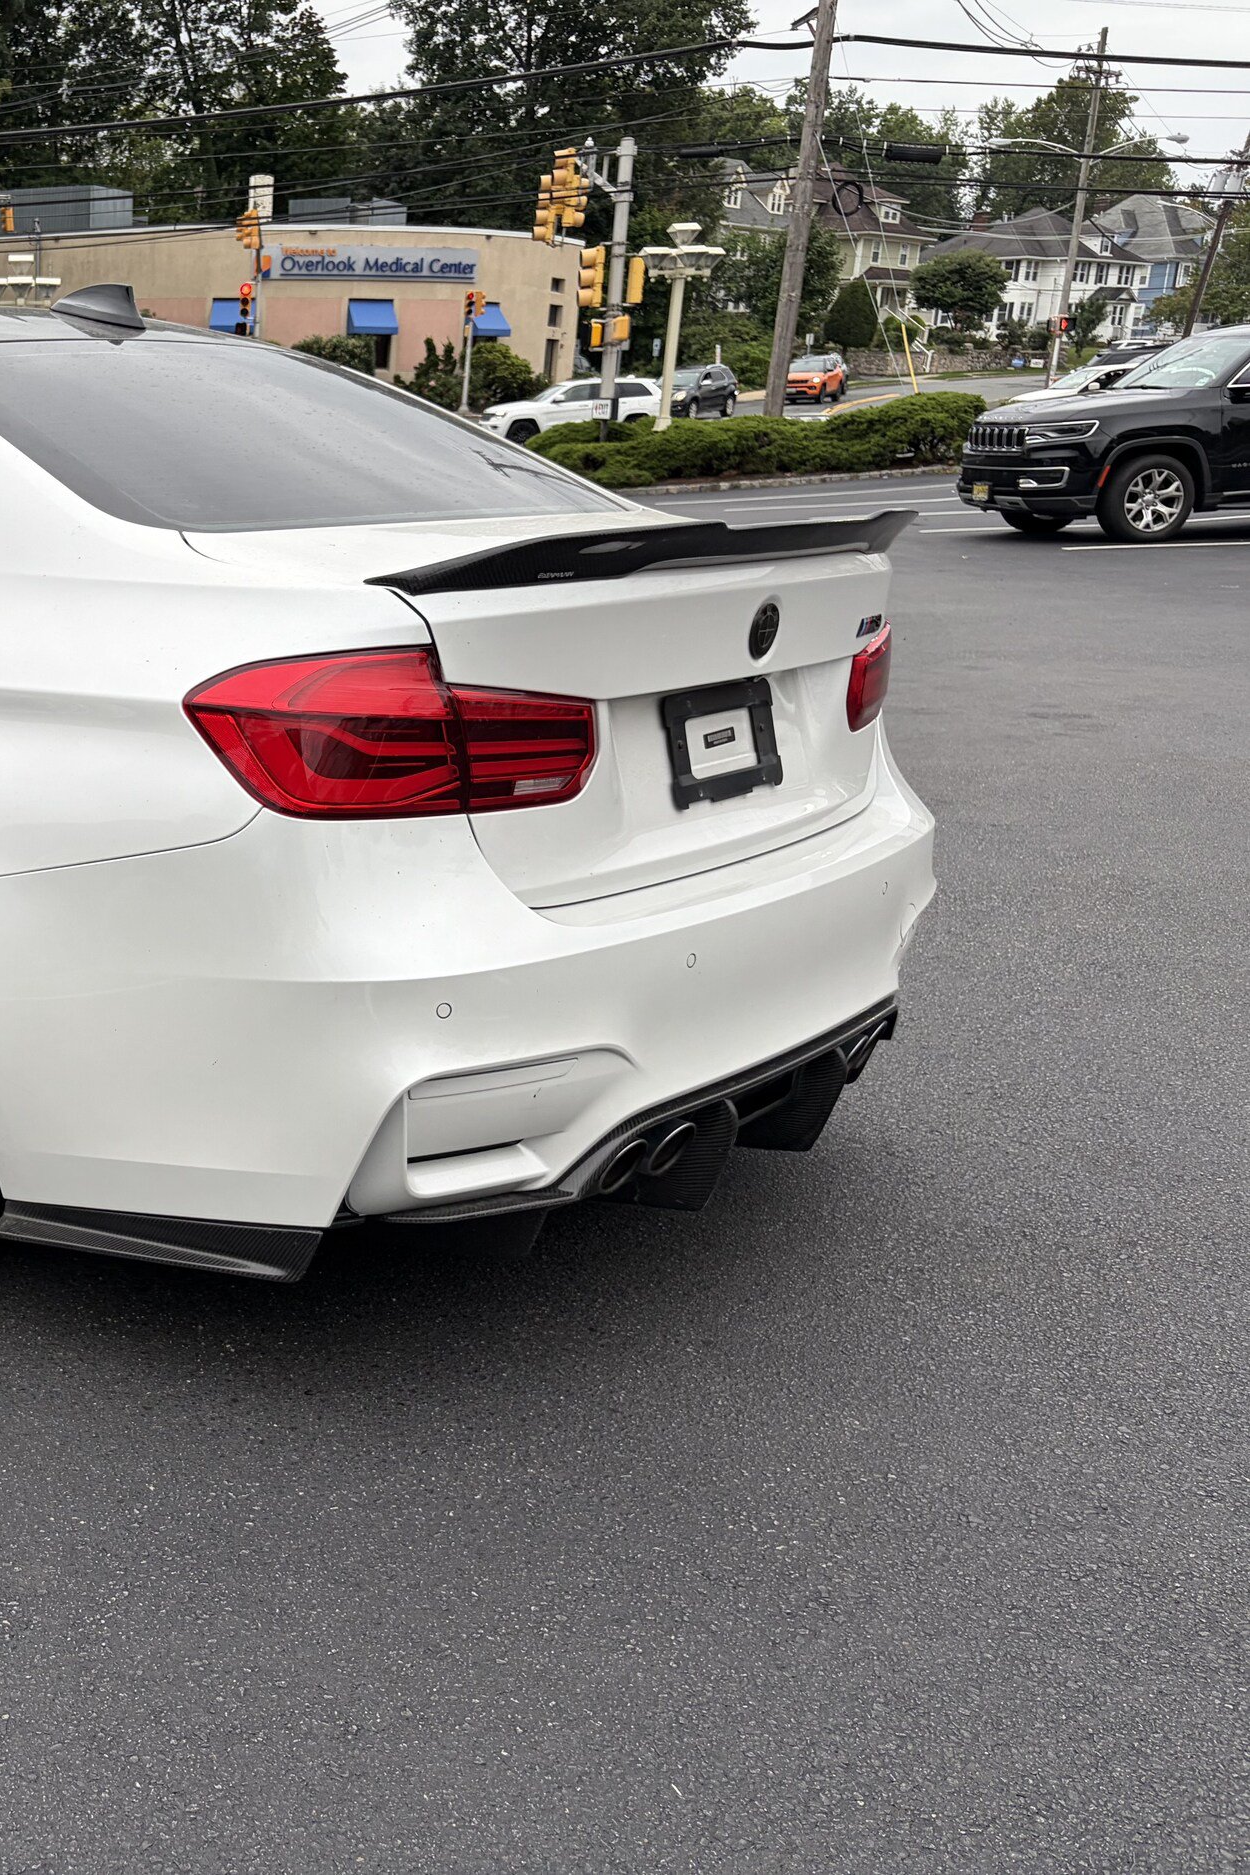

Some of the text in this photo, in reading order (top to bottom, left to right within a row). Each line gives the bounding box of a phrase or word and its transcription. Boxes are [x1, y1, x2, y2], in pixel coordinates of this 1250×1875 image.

[281, 247, 325, 257] Welcome
[280, 255, 476, 275] Overlook Medical Center
